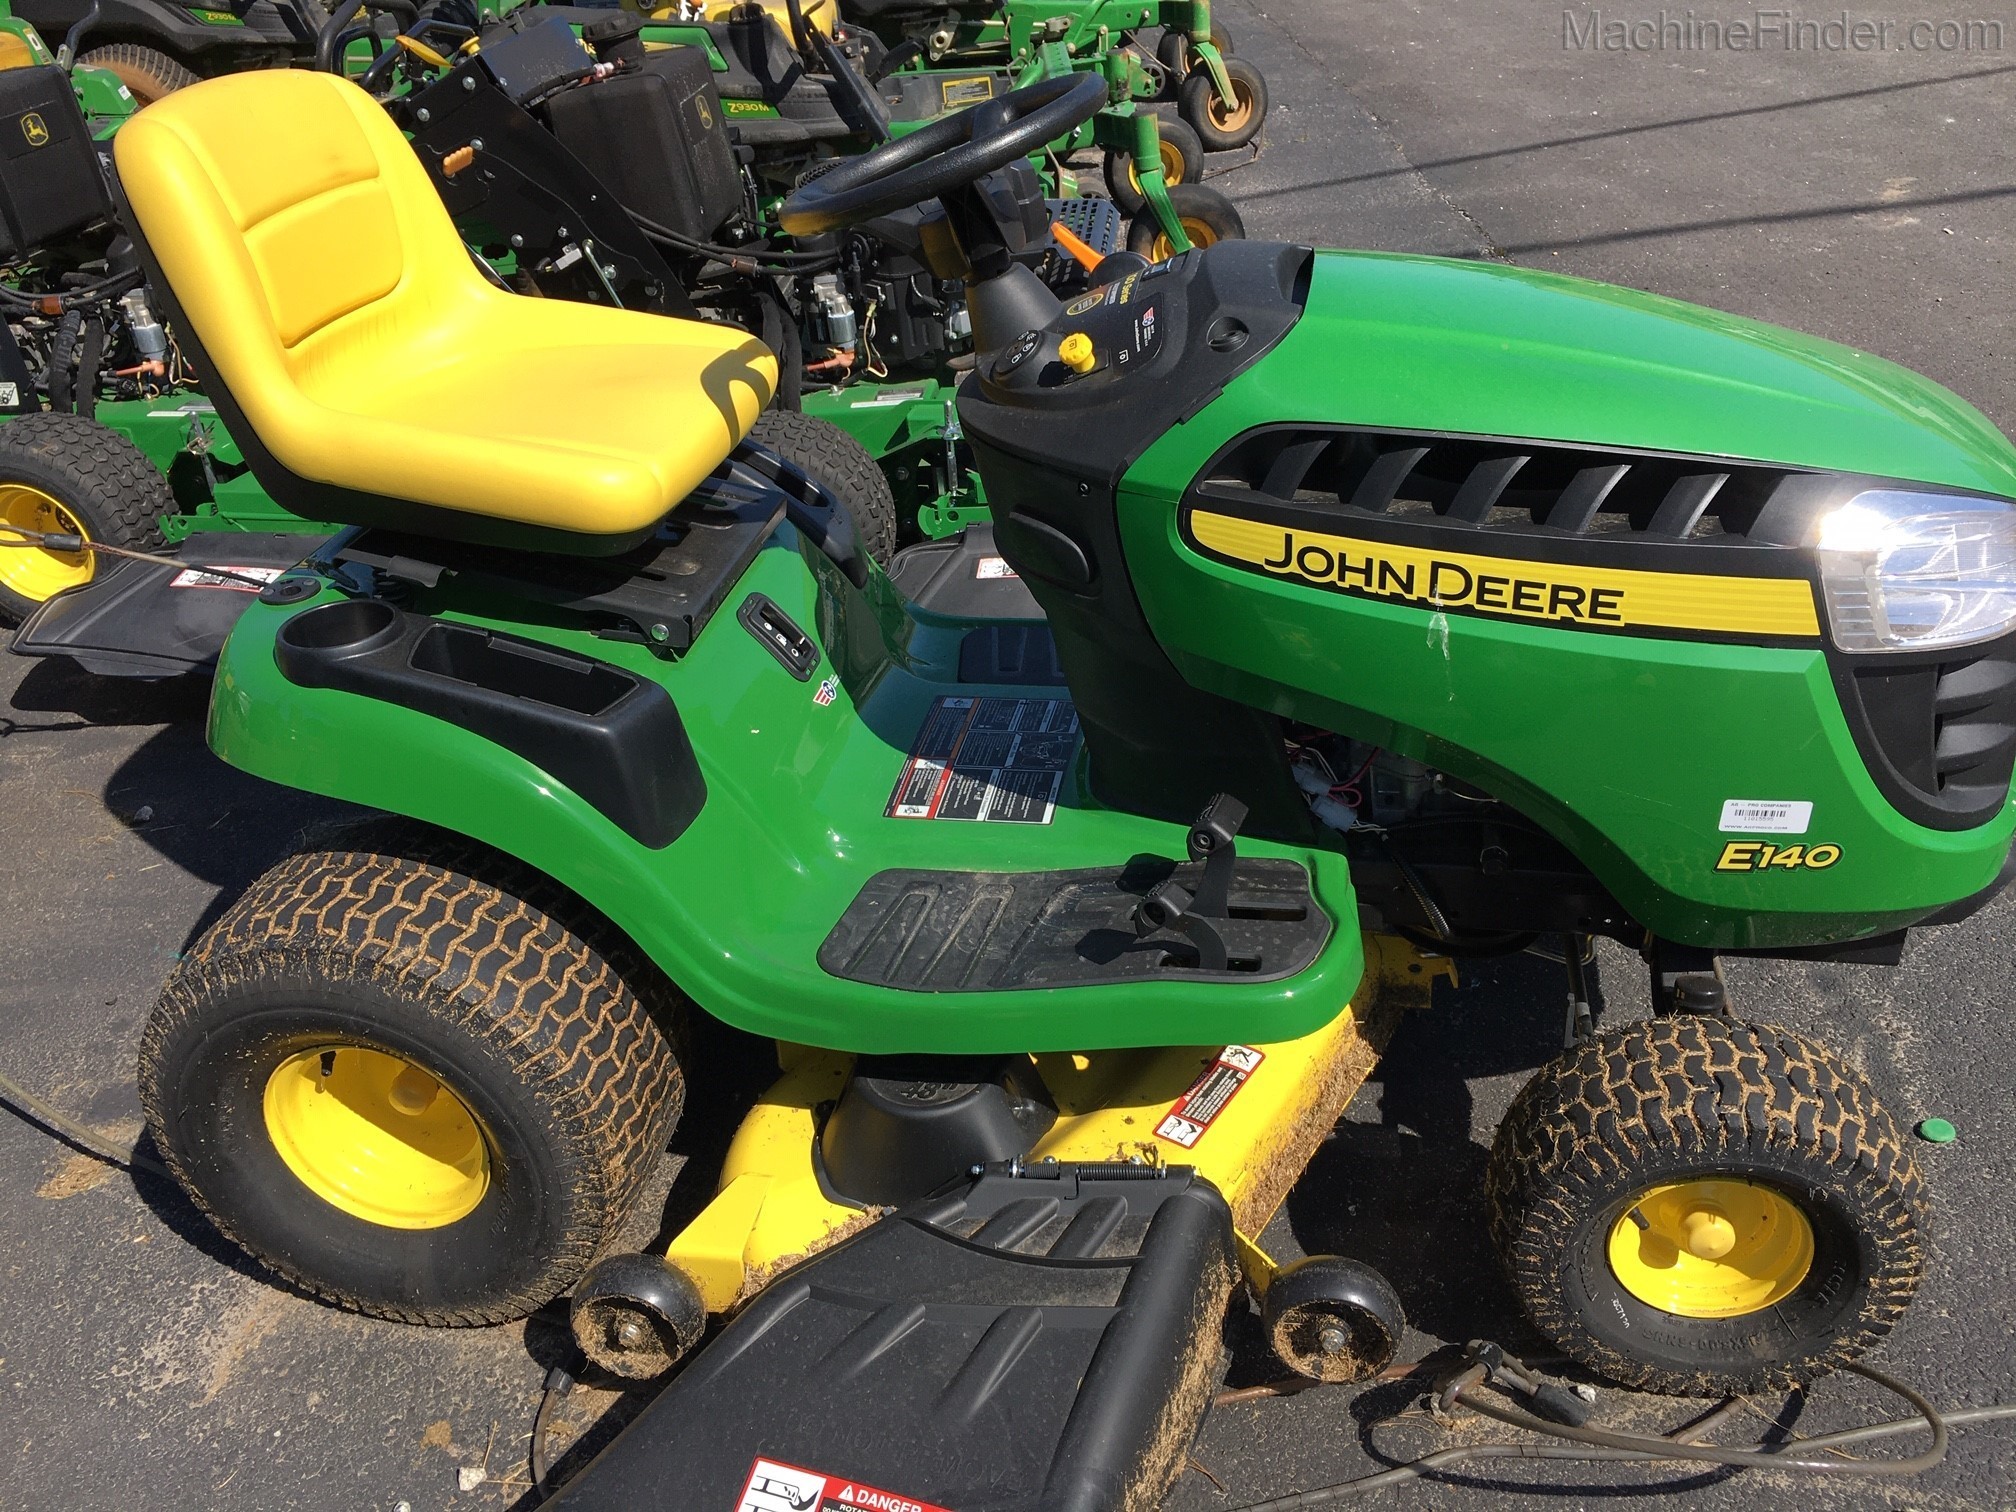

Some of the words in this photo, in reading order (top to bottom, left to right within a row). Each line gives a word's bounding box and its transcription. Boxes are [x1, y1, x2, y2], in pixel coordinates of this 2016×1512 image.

[727, 103, 769, 113] Z930M
[1264, 533, 1415, 595] JOHN
[1430, 561, 1625, 621] DEERE
[1716, 842, 1841, 870] E140
